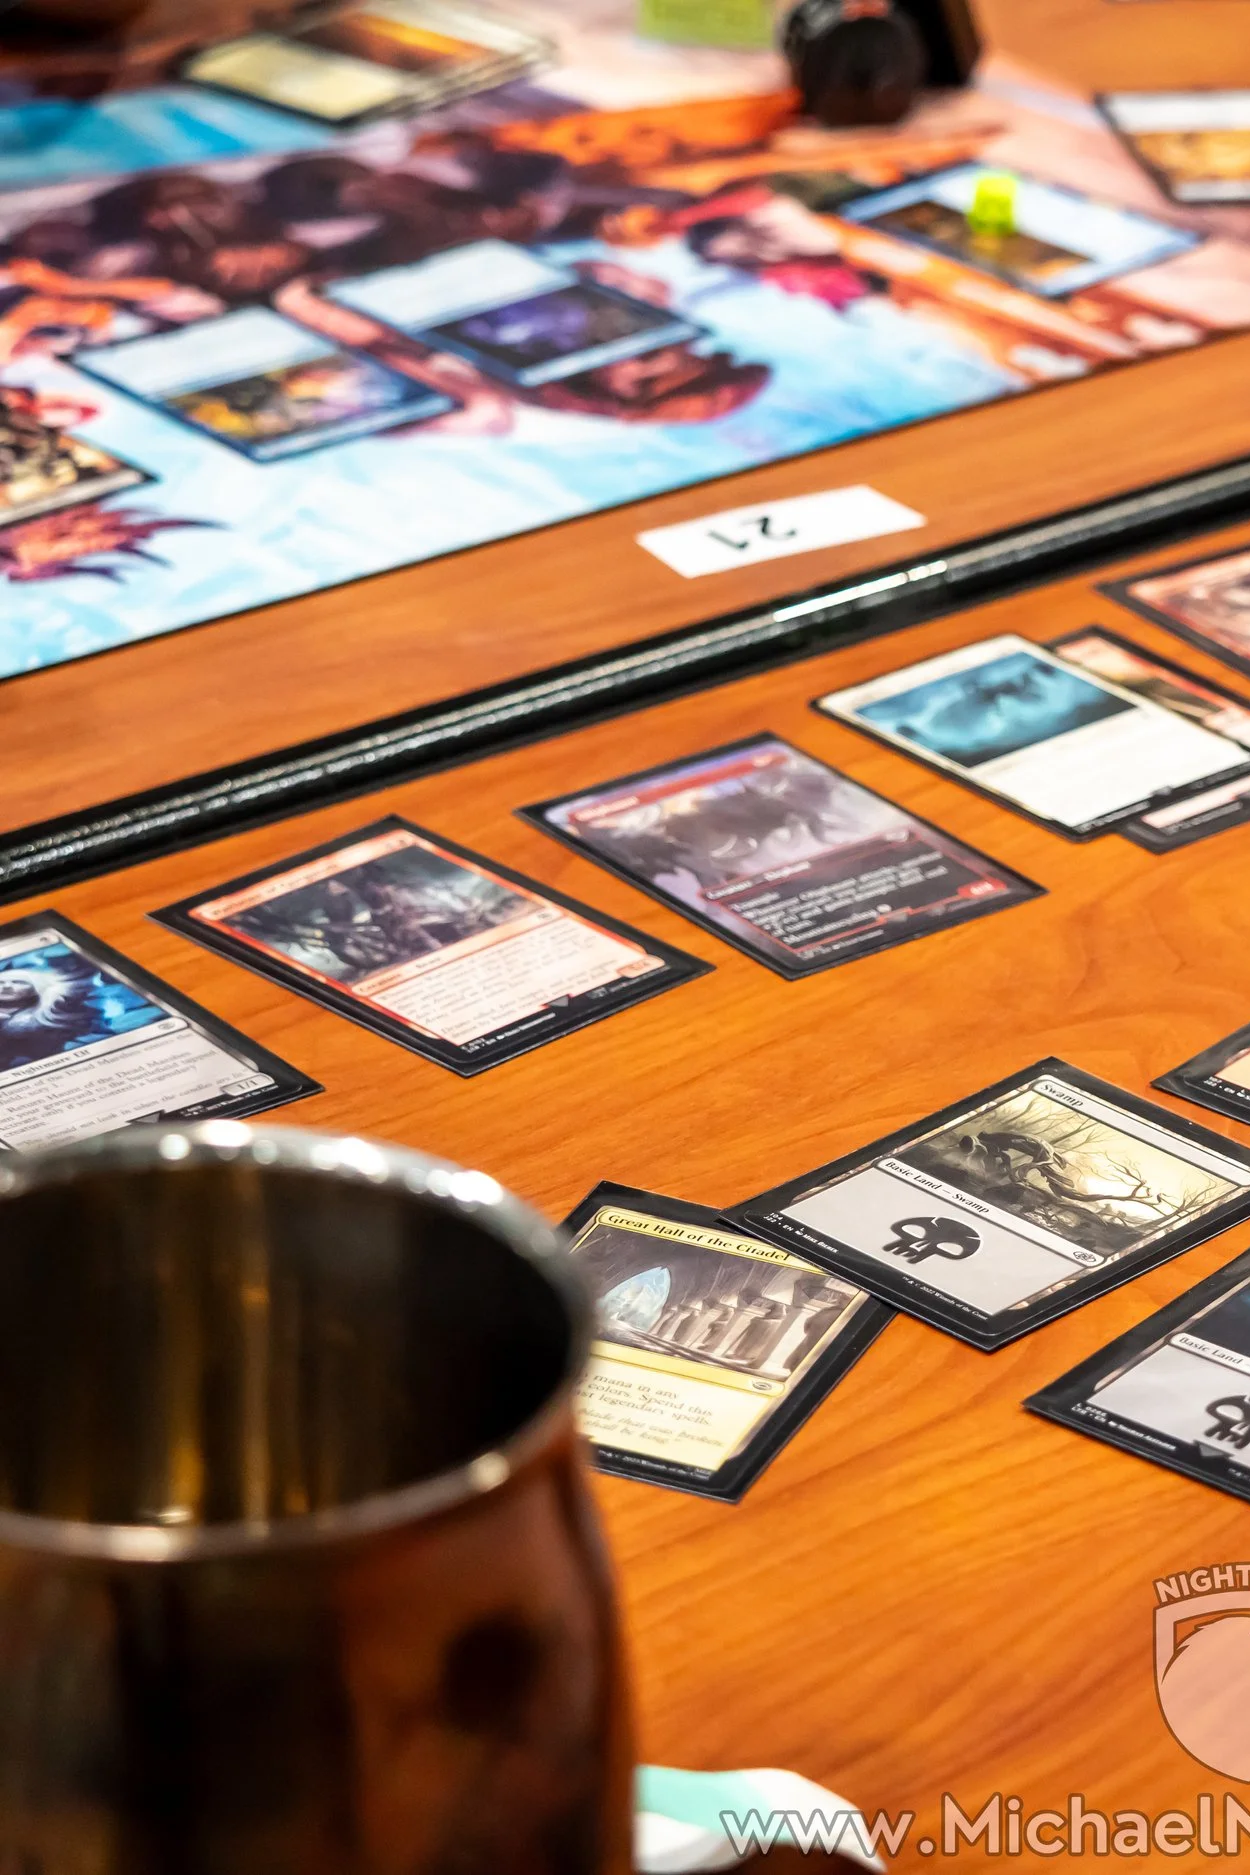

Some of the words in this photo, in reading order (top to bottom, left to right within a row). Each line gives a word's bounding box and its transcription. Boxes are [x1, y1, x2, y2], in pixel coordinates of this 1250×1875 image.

[705, 516, 798, 552] 21
[12, 1055, 71, 1078] Nightmare
[1041, 1084, 1084, 1107] Swamp
[885, 1161, 915, 1177] Basic
[913, 1175, 943, 1191] Land
[952, 1193, 990, 1213] Swamp
[608, 1214, 648, 1229] Great
[653, 1224, 684, 1238] Hall
[687, 1233, 705, 1242] of
[707, 1237, 733, 1249] the
[736, 1243, 791, 1262] Citadel
[1179, 1337, 1210, 1352] Basic
[1211, 1349, 1244, 1365] Land
[593, 1375, 633, 1389] mana
[637, 1385, 651, 1393] in
[655, 1389, 679, 1401] any
[599, 1393, 664, 1416] legendary
[671, 1412, 712, 1426] spells.
[639, 1394, 684, 1411] Spend
[688, 1405, 713, 1417] this
